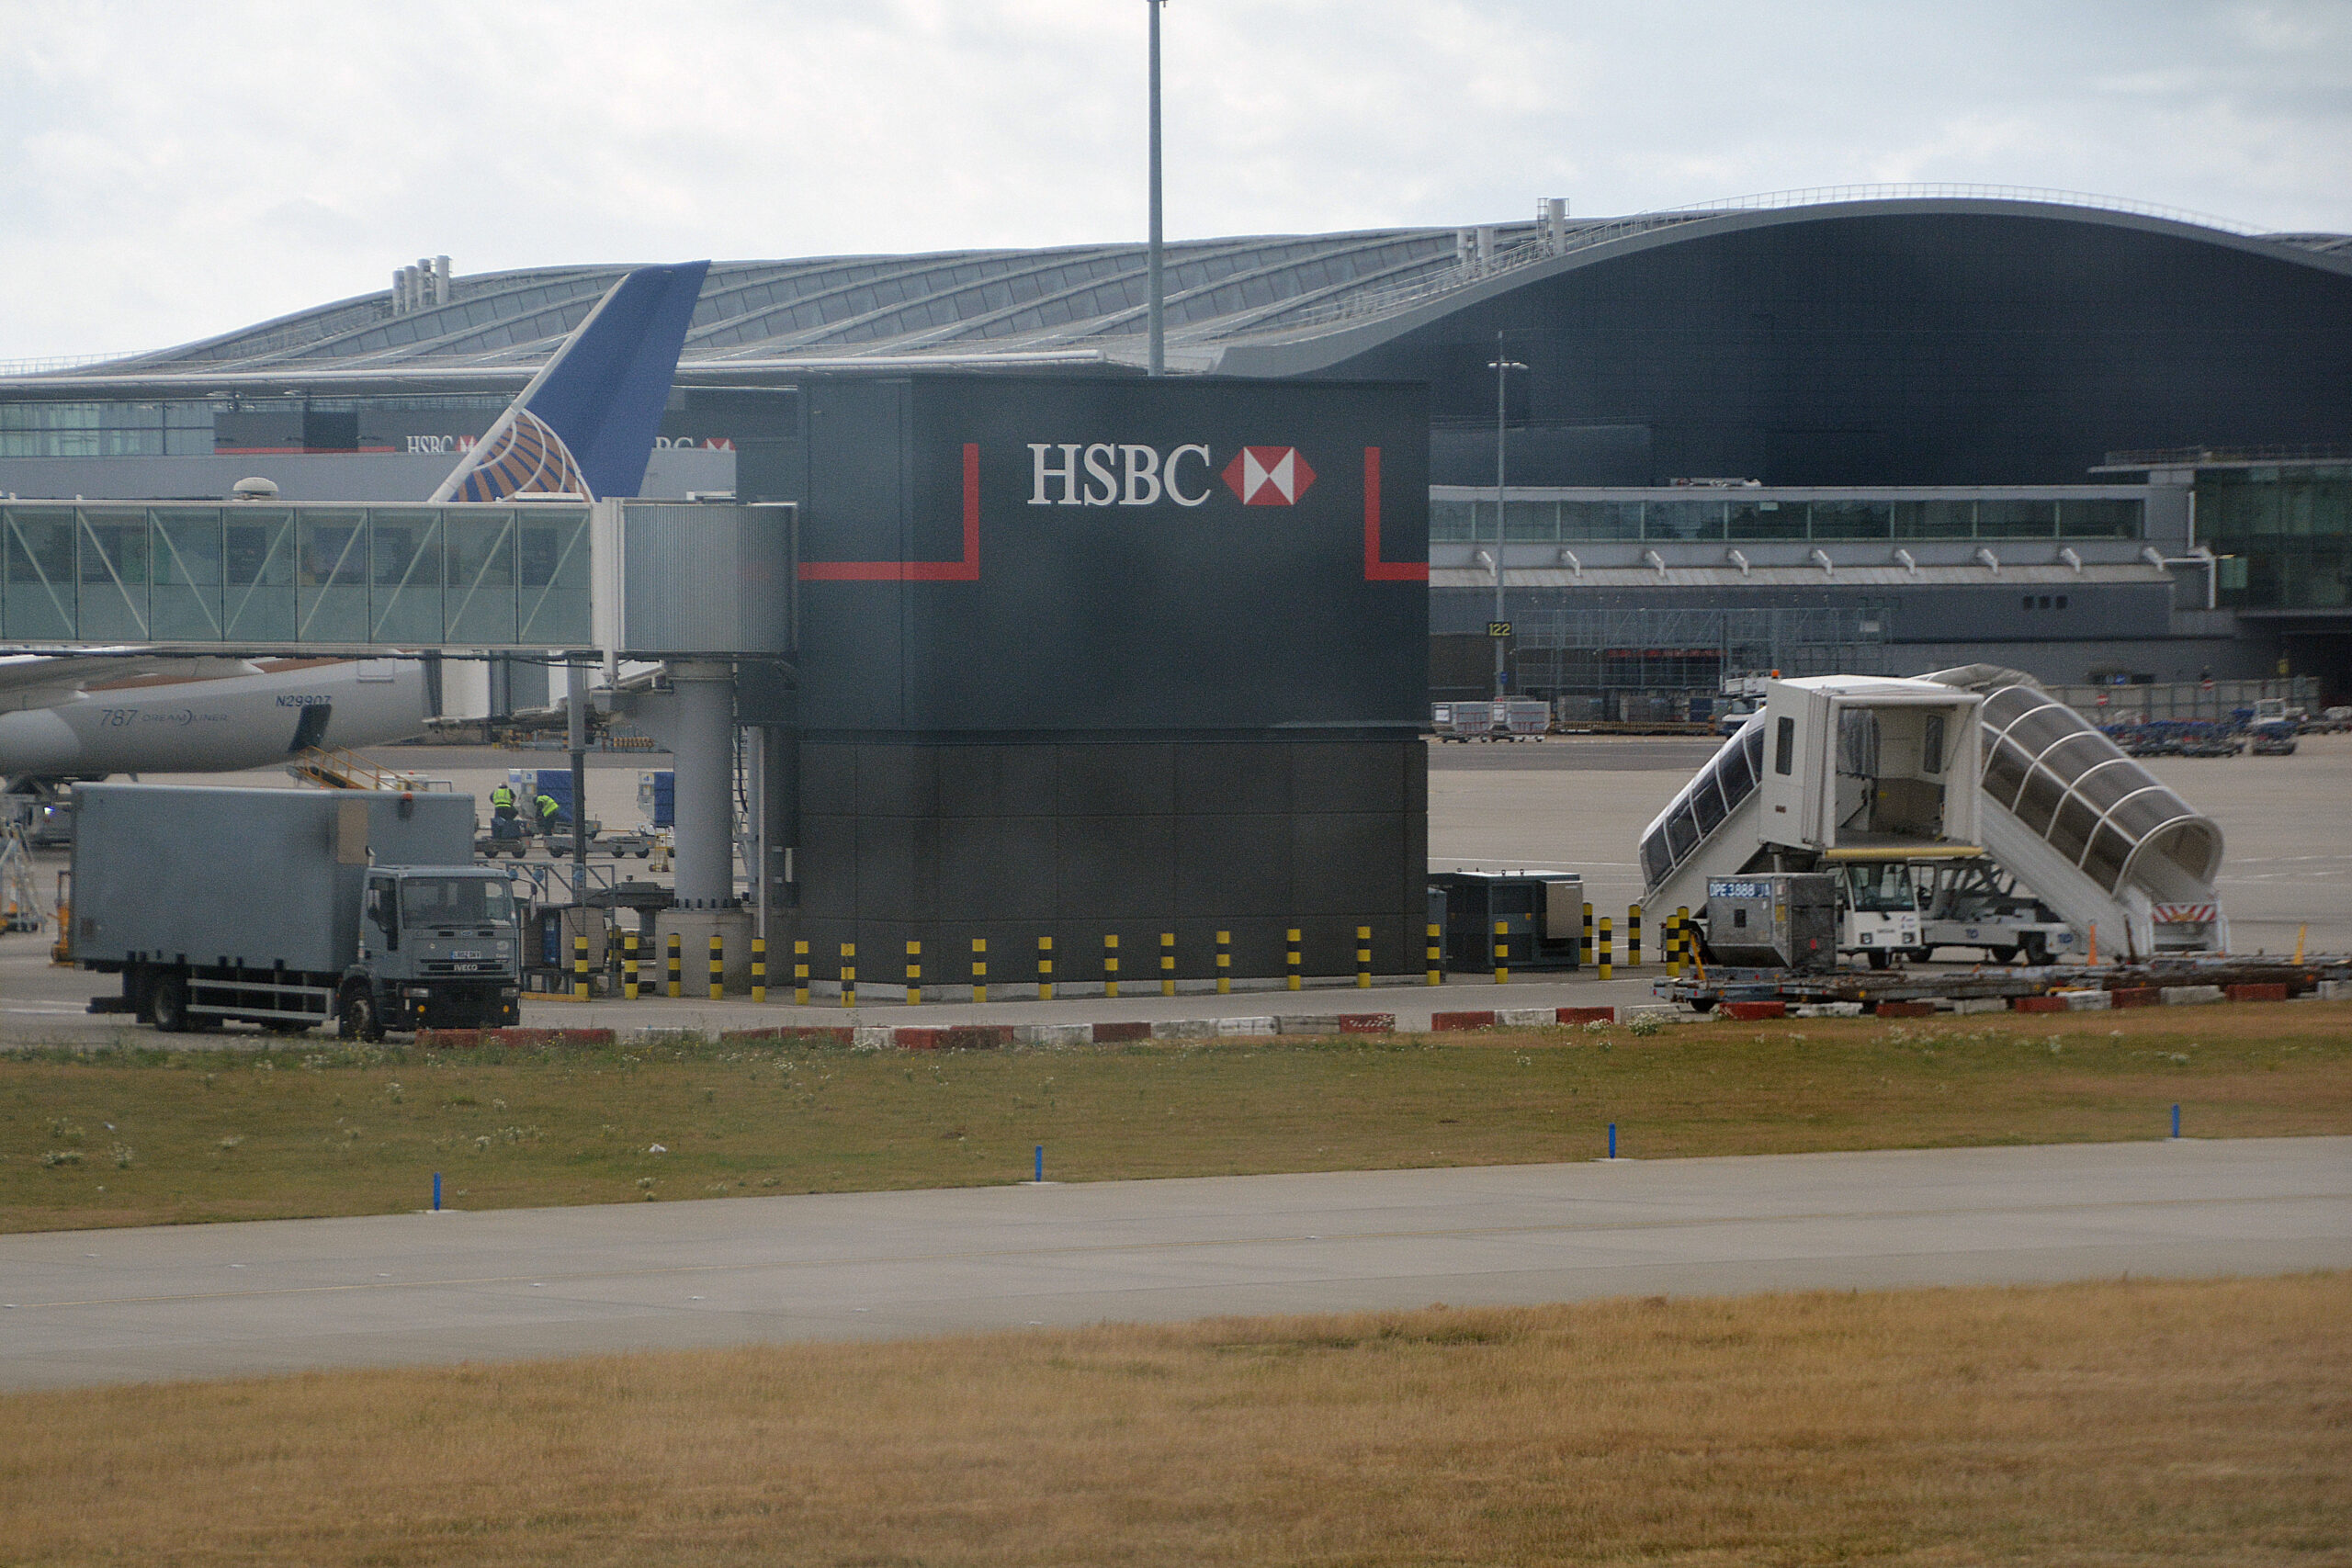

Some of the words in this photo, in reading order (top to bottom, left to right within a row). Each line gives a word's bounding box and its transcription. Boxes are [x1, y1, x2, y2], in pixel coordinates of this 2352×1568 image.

[1027, 443, 1211, 506] HSBC
[1489, 623, 1510, 637] 122
[276, 694, 332, 706] N29907
[101, 709, 138, 726] 787
